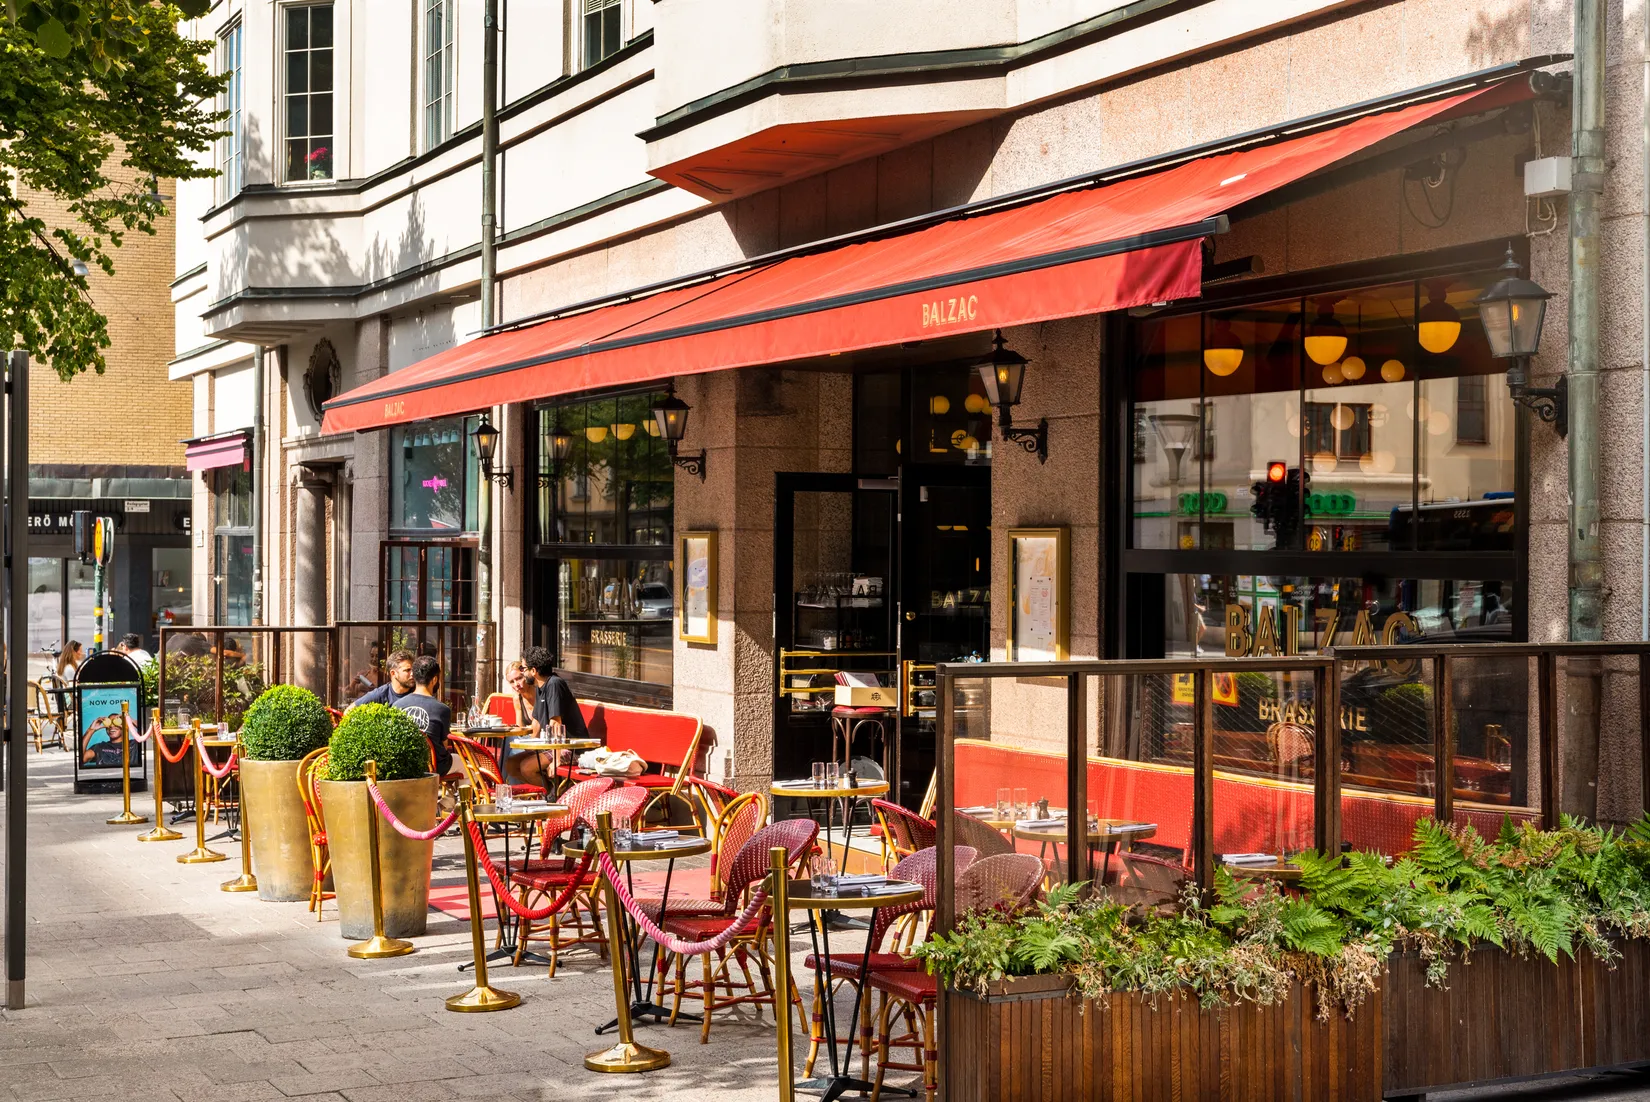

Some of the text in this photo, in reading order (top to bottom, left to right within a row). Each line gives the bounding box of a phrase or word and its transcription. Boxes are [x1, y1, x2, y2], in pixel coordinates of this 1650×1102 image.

[922, 295, 978, 328] BALZAC
[384, 401, 405, 418] BALZAC
[579, 576, 645, 615] BALZAC
[590, 630, 627, 647] BRASSERIE
[1225, 604, 1424, 677] BALZAC
[1259, 698, 1367, 732] BRASSRIE
